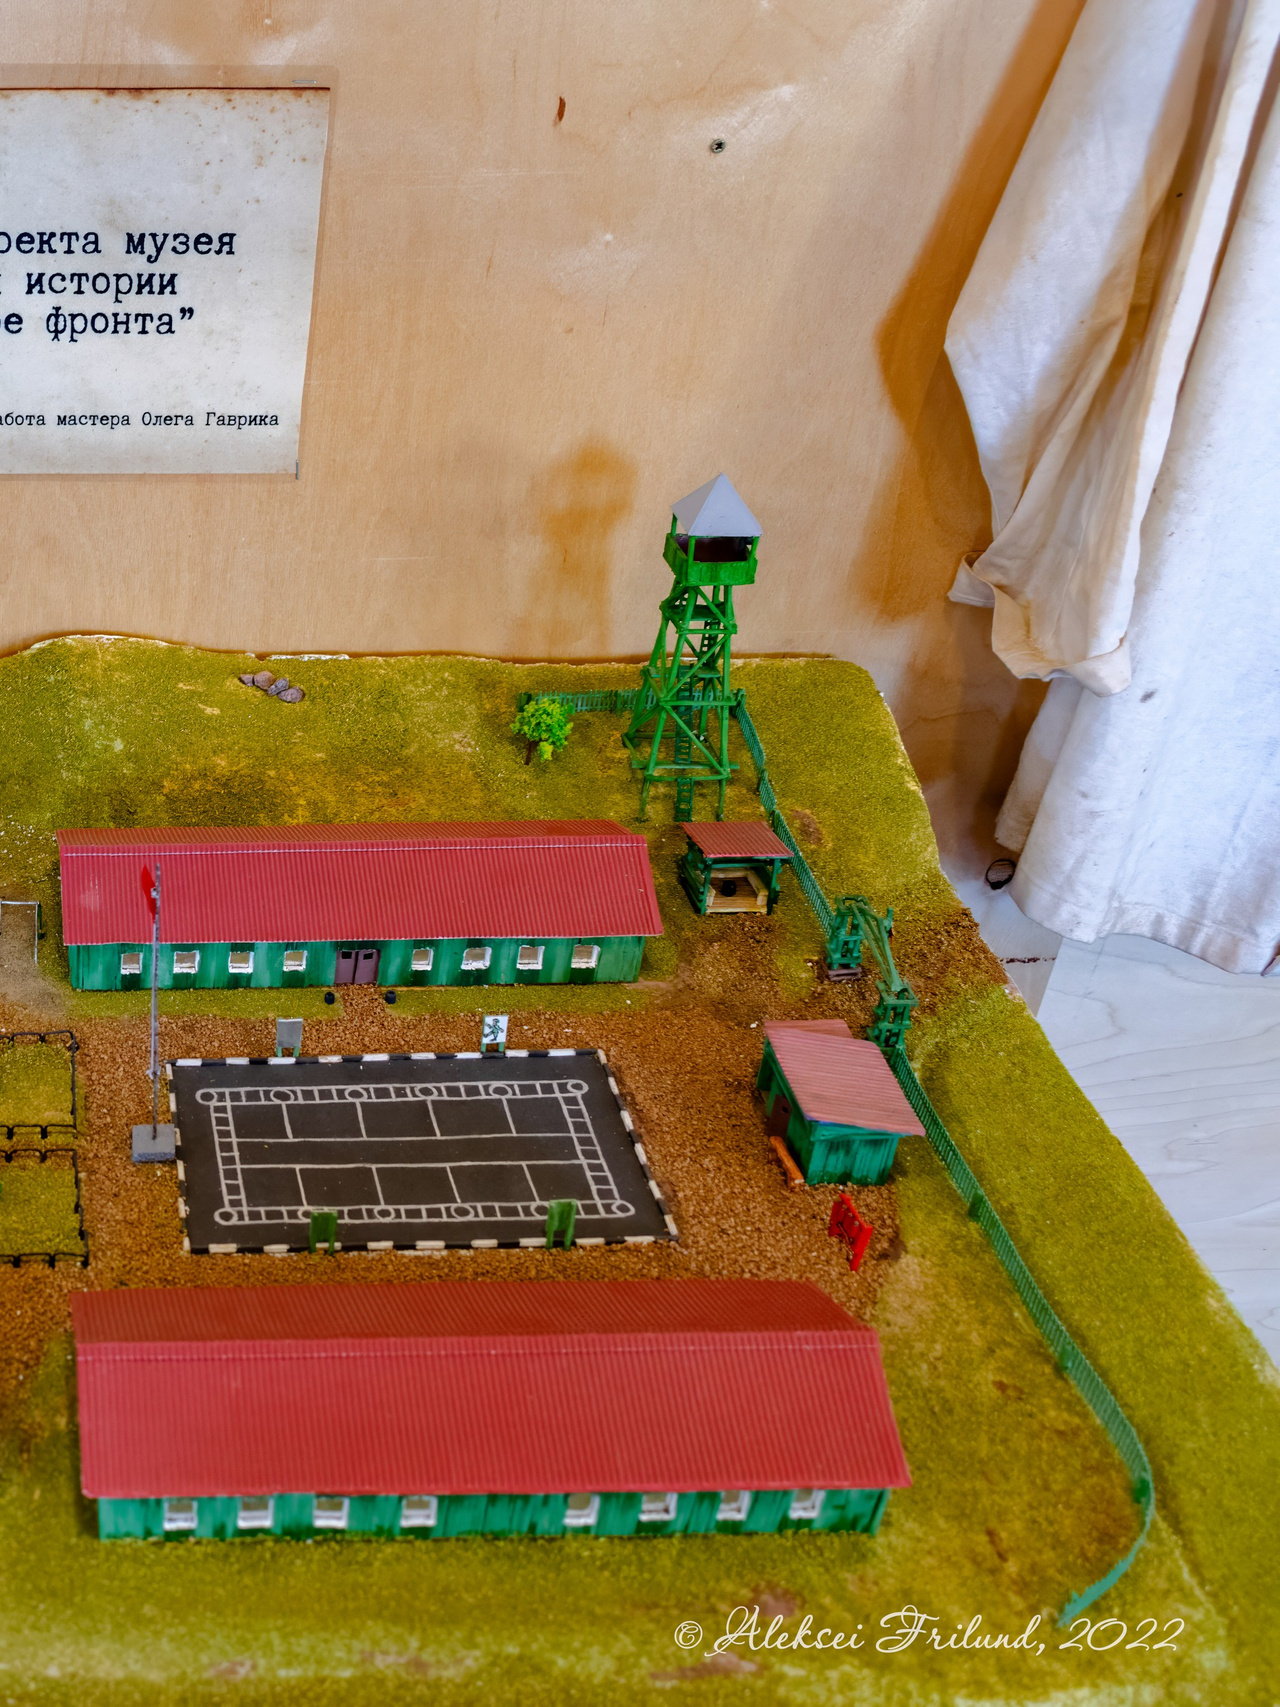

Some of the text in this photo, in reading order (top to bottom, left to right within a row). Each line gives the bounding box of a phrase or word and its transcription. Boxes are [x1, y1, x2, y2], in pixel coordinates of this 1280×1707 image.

[125, 232, 237, 264] музея
[25, 272, 179, 304] истории
[45, 305, 195, 343] фронта”
[56, 414, 131, 430] мастера
[141, 411, 195, 426] Олега
[205, 411, 279, 430] Гаврика
